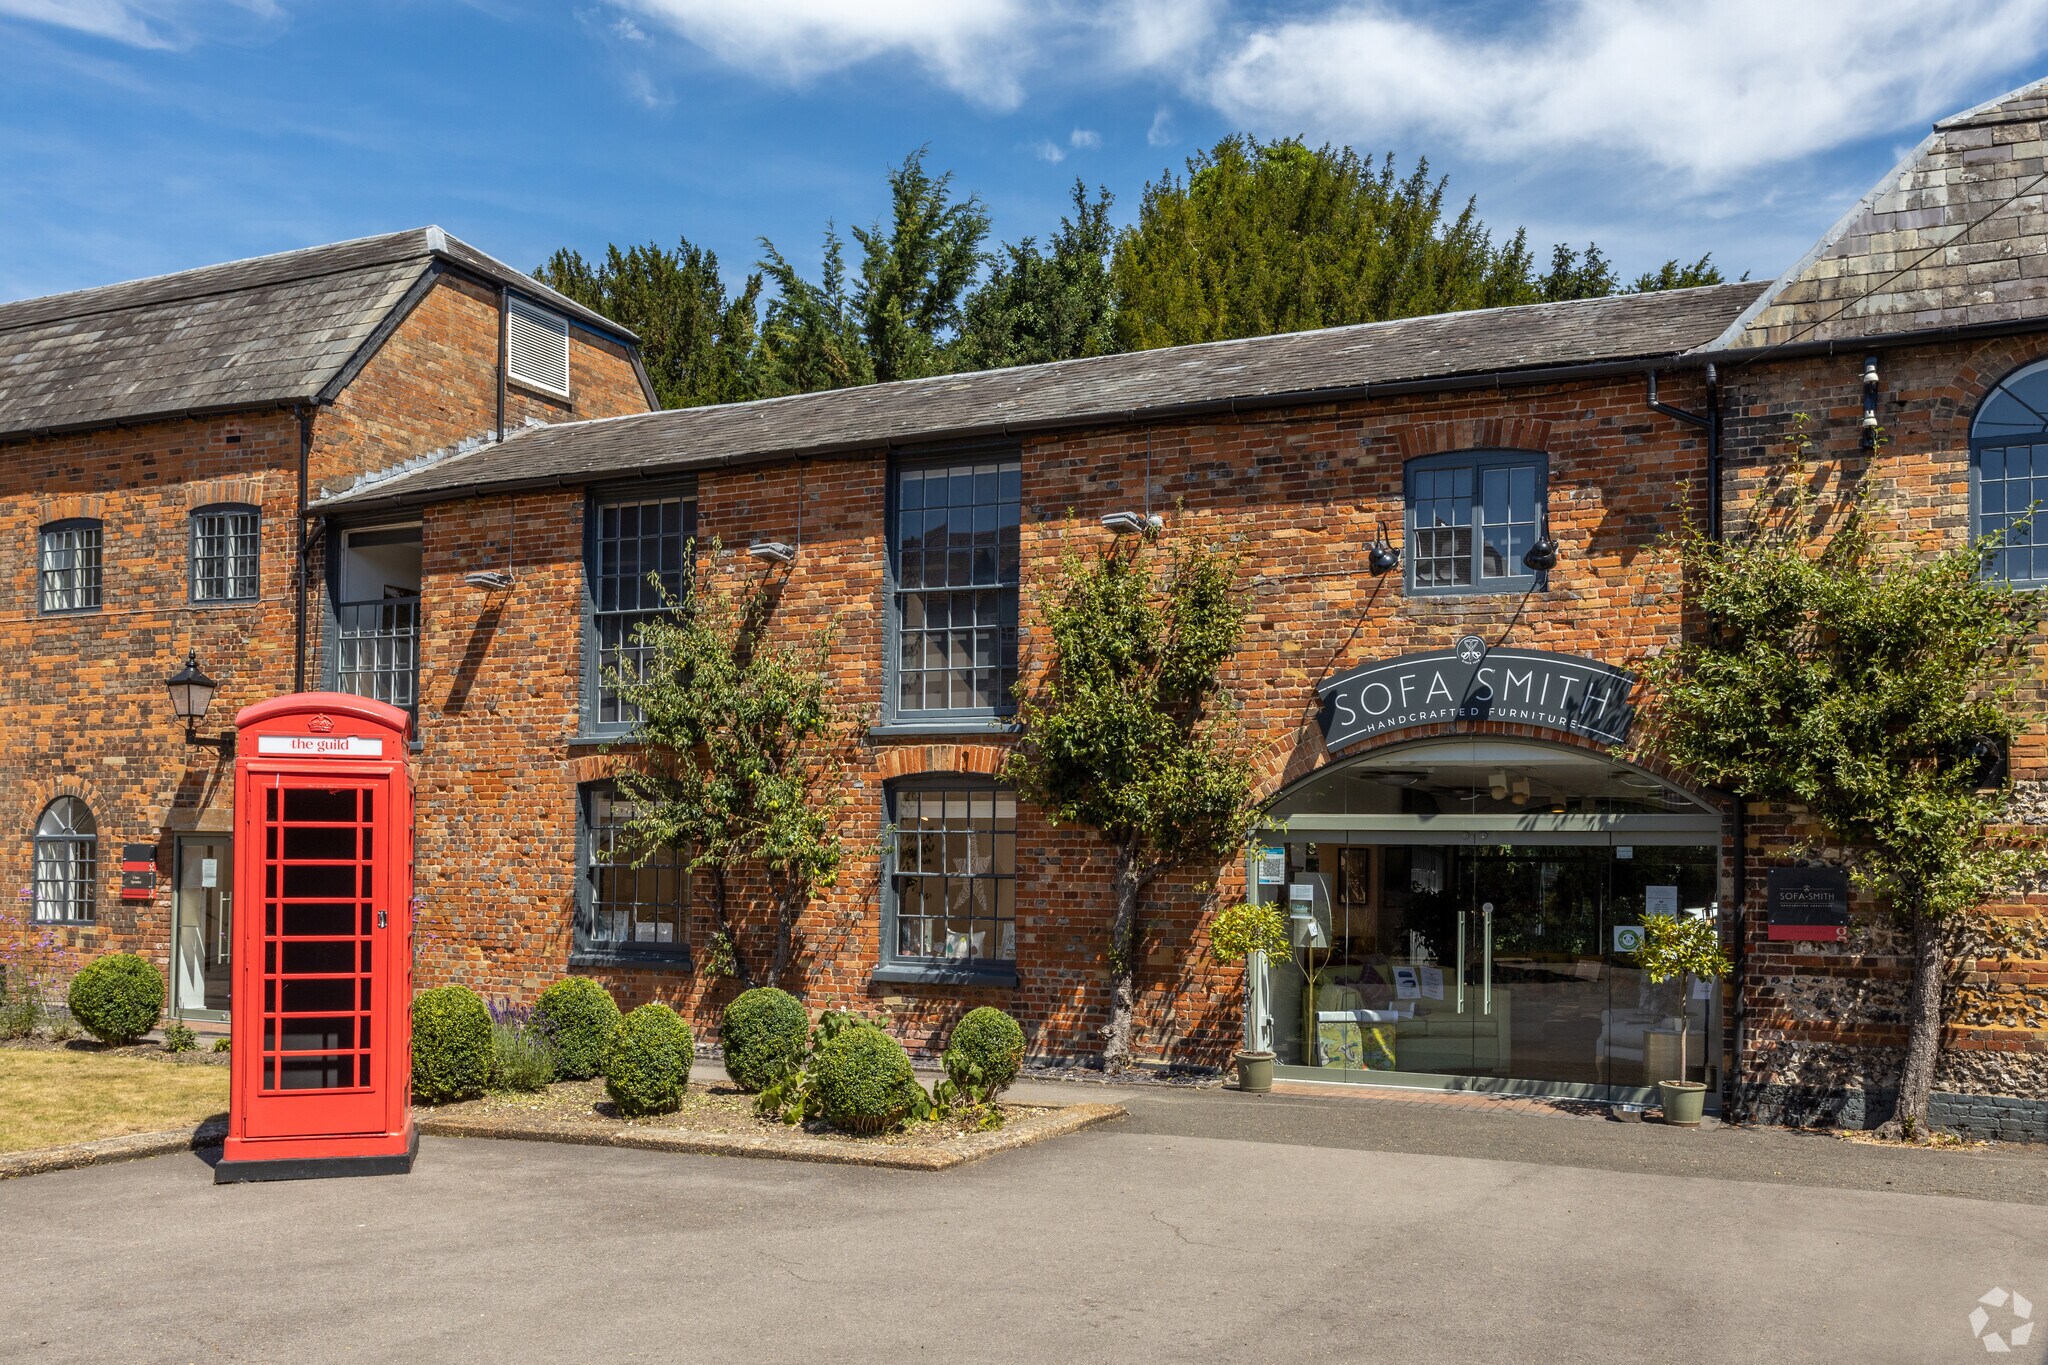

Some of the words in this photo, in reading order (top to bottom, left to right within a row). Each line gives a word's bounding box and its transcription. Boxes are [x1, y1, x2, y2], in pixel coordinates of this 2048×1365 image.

[1334, 670, 1453, 726] SOFA
[1475, 667, 1612, 720] SMITH
[1366, 707, 1480, 733] HANDCRAFTED
[1488, 707, 1578, 729] FURNITURE
[291, 739, 314, 750] the
[317, 739, 349, 752] guild
